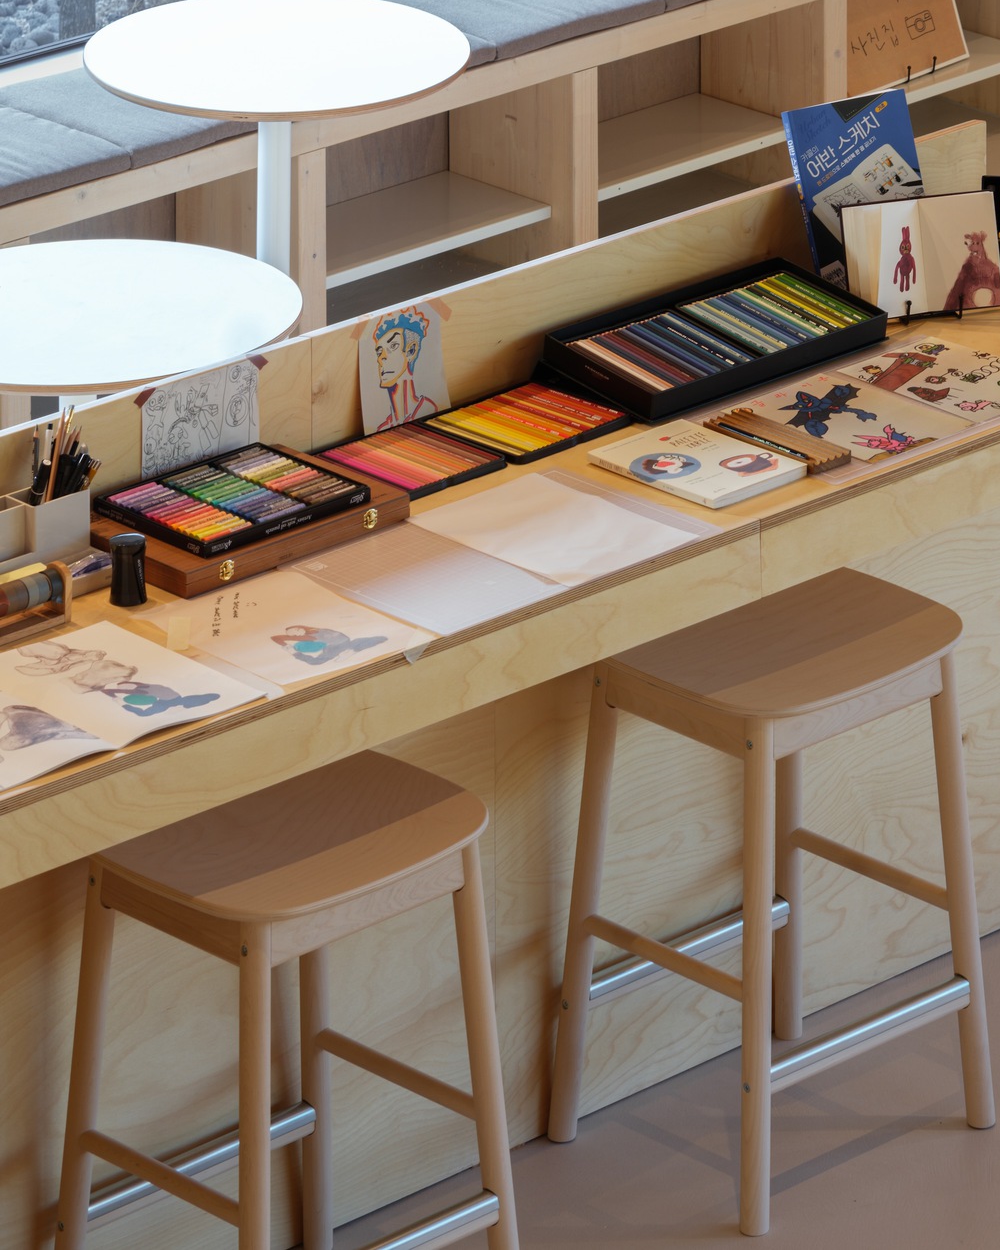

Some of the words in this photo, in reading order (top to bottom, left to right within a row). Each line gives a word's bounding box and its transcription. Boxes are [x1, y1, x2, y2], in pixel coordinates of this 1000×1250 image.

[850, 20, 900, 56] 사진집
[806, 145, 838, 178] 어반
[837, 111, 880, 156] 스케치
[669, 431, 704, 447] PALETTE
[686, 437, 712, 449] TABLE
